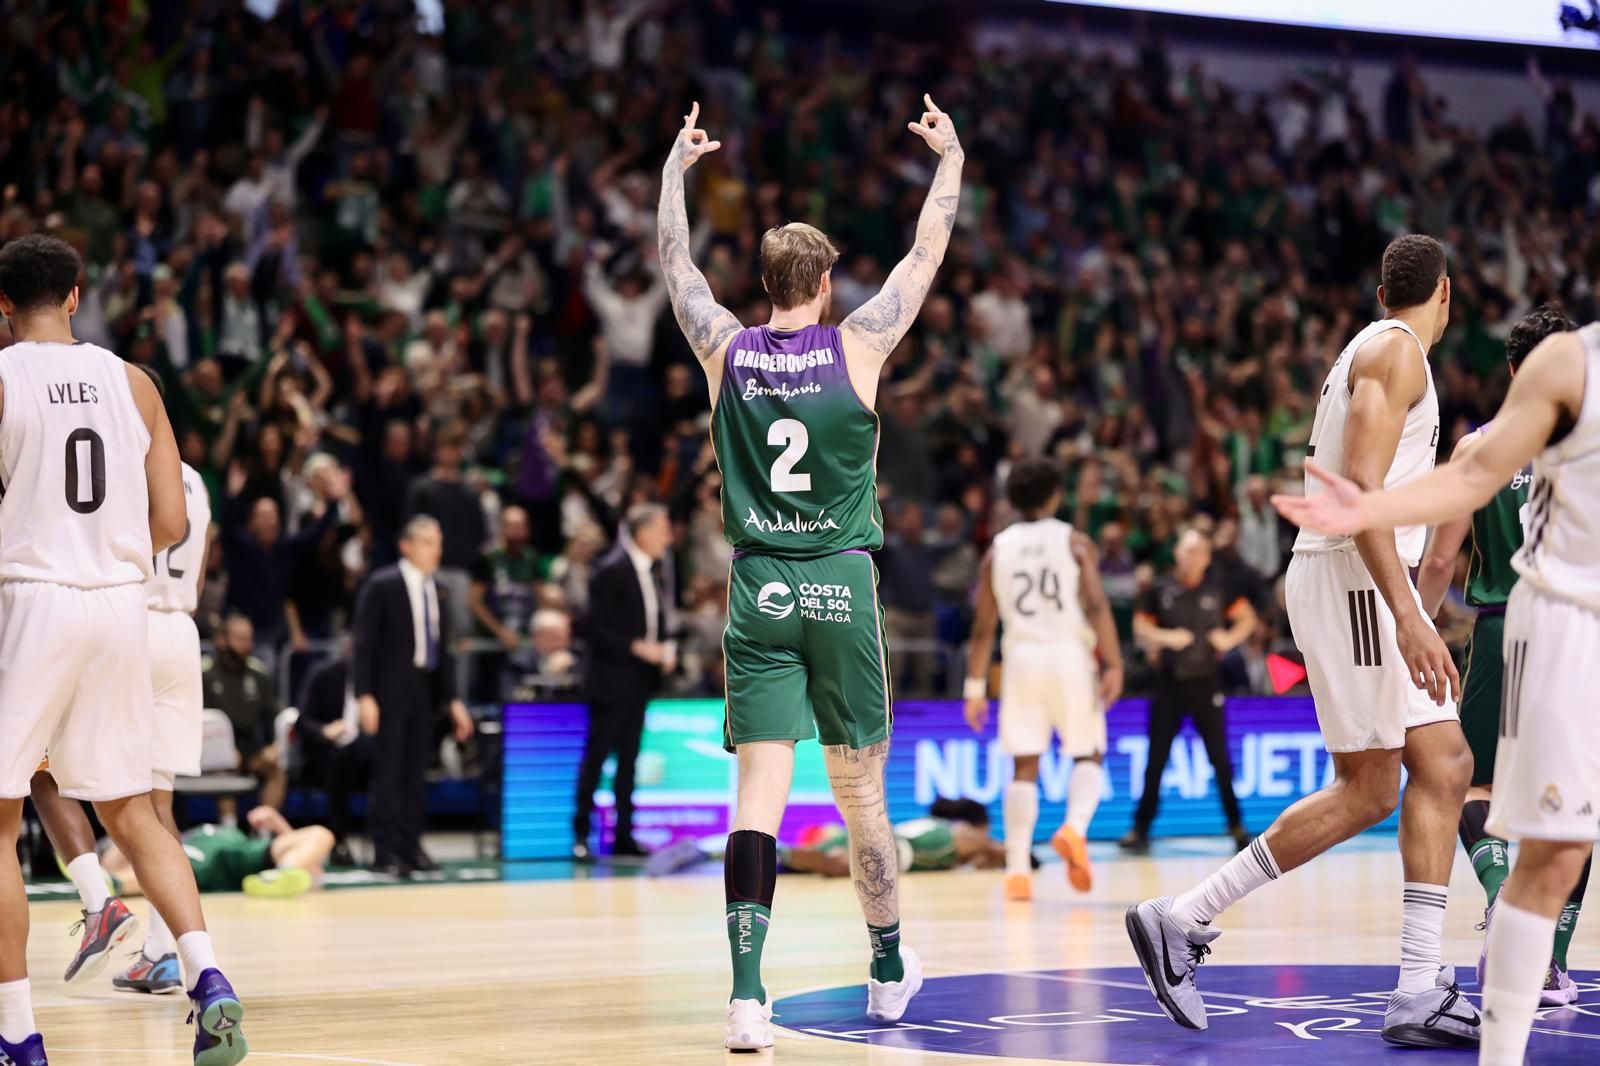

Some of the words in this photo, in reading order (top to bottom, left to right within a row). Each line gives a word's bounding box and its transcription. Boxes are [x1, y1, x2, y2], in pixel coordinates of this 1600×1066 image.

[47, 383, 98, 404] LYLES
[767, 418, 811, 492] 2
[65, 427, 106, 514] 0
[743, 506, 841, 533] Andalucía
[799, 583, 851, 599] COSTA
[800, 597, 824, 609] DEL
[827, 599, 852, 612] SOL
[1013, 566, 1063, 617] 24
[800, 609, 851, 624] MÁLAGA
[738, 911, 752, 954] UNICAJA
